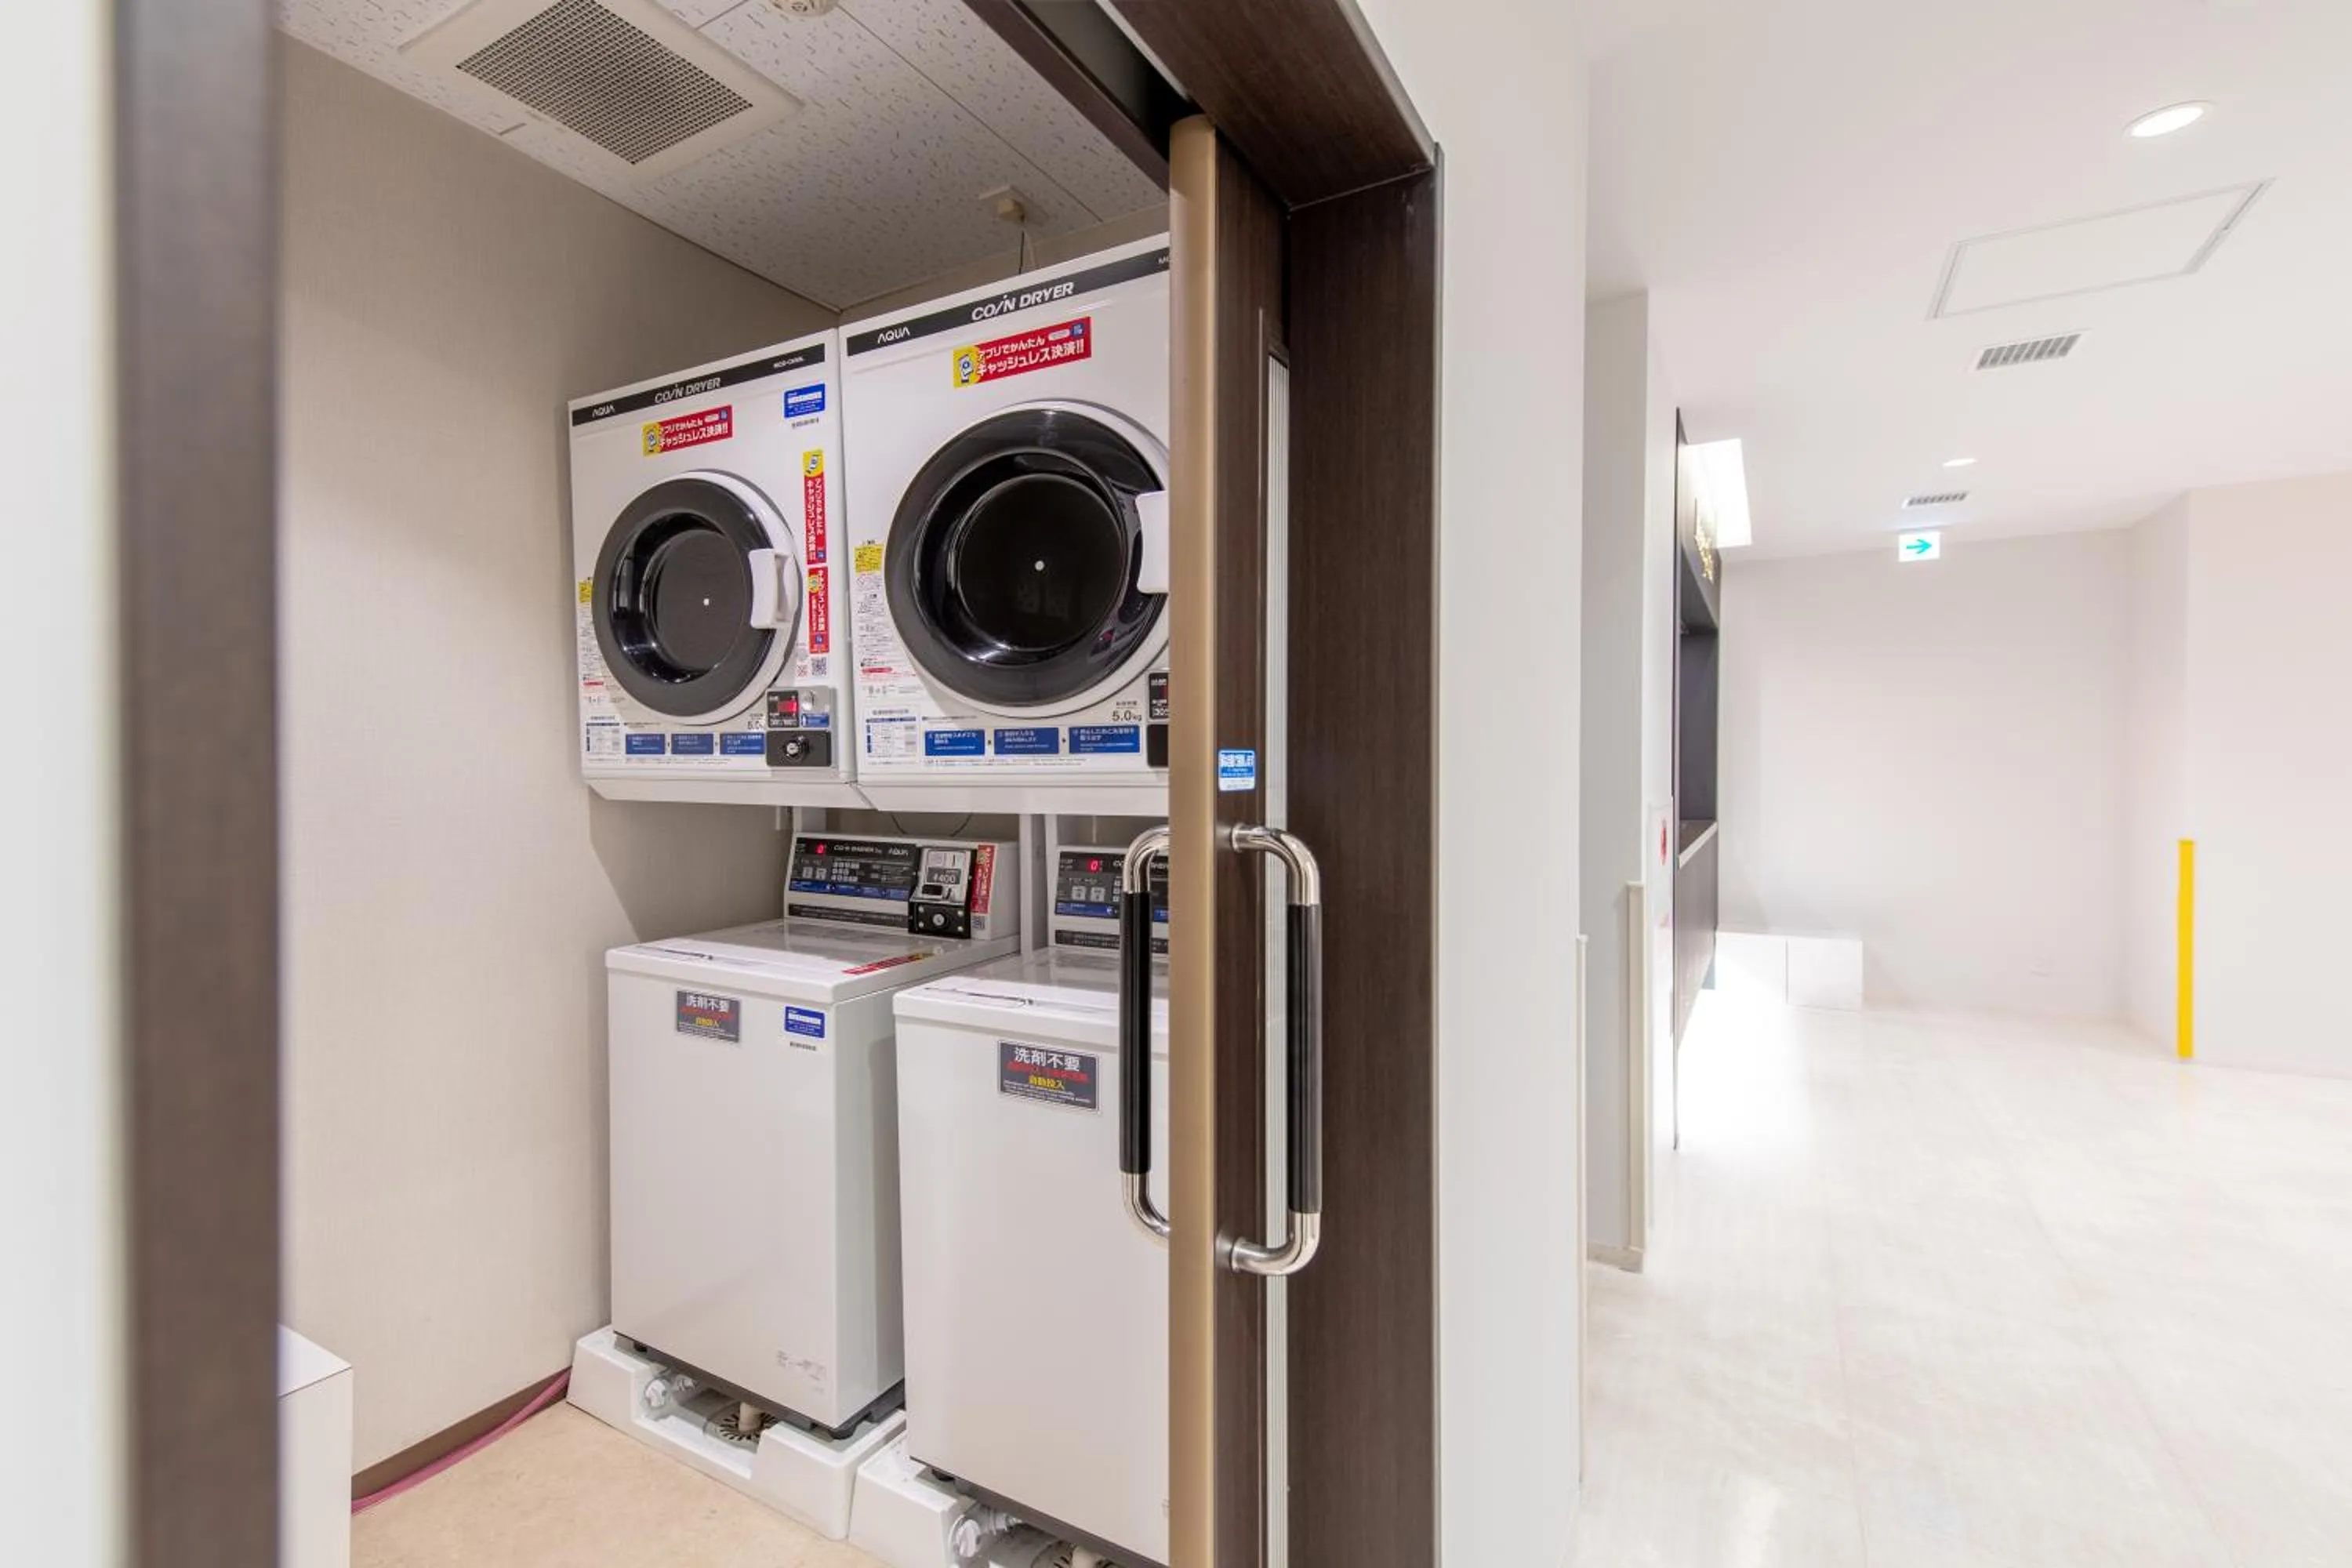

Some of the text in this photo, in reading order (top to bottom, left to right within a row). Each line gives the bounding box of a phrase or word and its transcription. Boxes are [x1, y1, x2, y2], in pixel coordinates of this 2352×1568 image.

[1018, 282, 1074, 308] DRYER
[877, 325, 911, 344] AQUA
[978, 336, 1045, 360] アプリでかんたん
[684, 377, 721, 397] DRYER
[592, 404, 615, 418] AQUA
[1014, 1047, 1080, 1072] 洗剤不要
